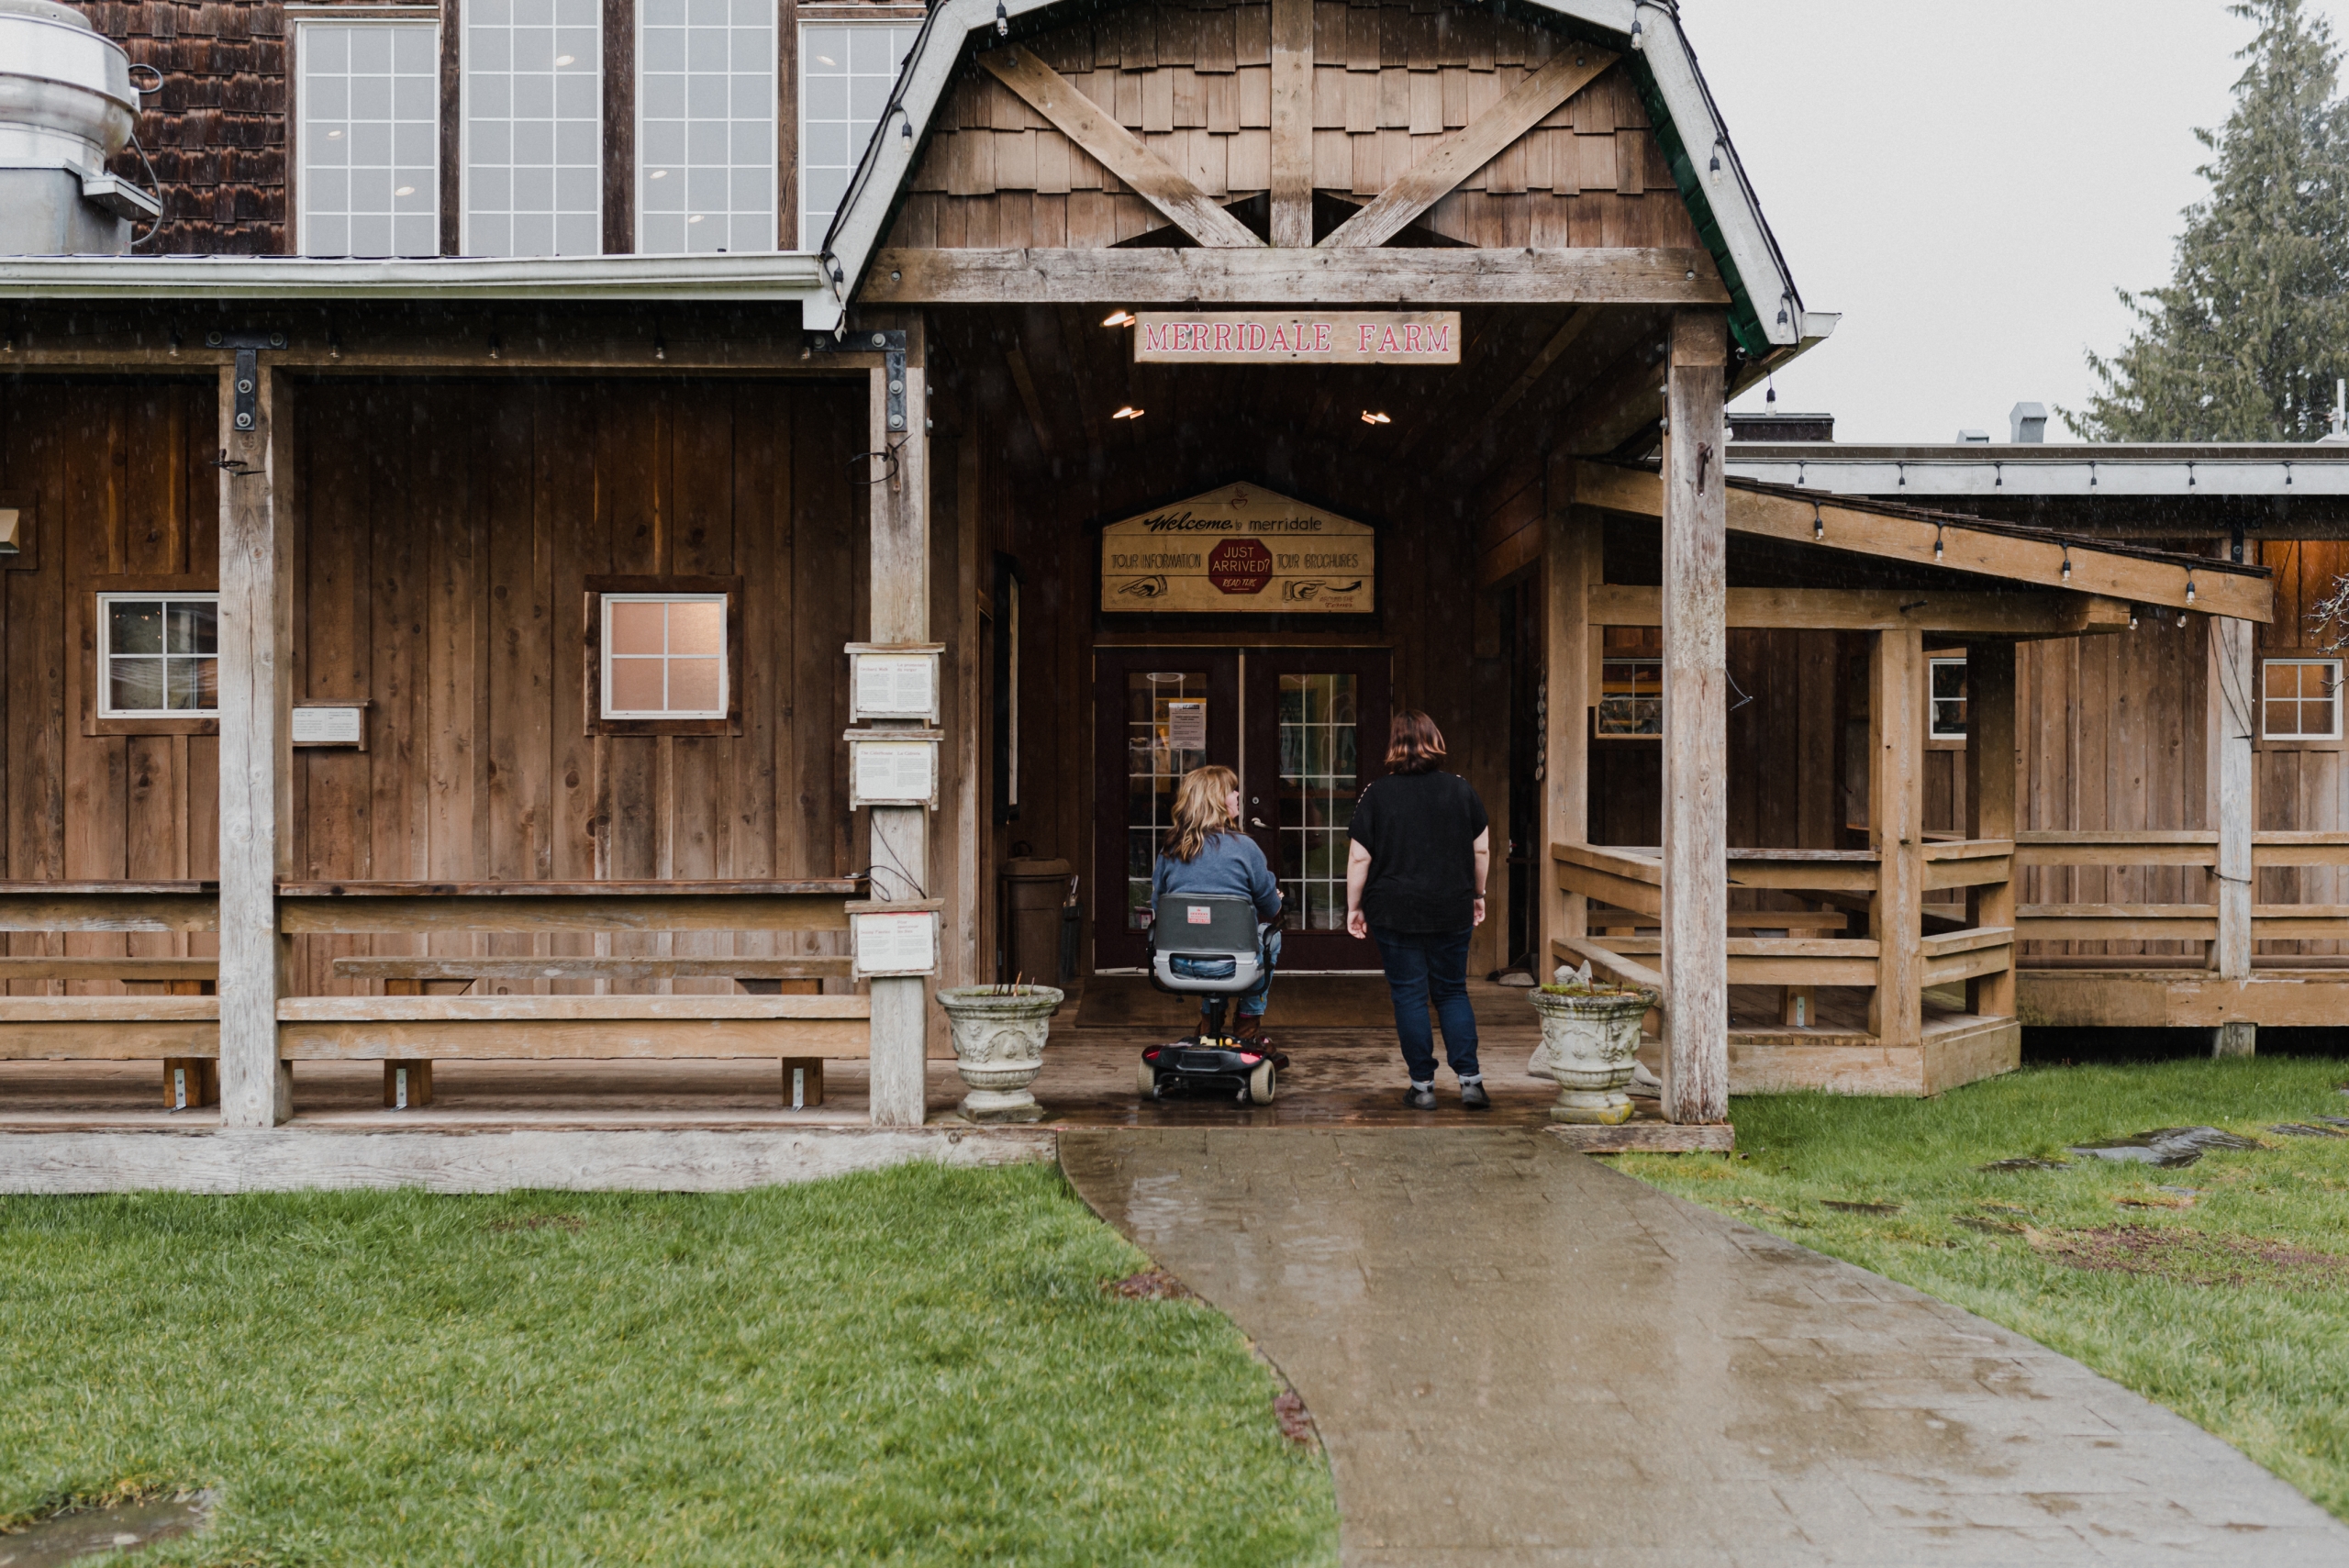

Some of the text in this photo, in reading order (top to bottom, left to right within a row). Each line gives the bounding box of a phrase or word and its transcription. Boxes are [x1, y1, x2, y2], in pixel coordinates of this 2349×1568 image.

[1145, 323, 1451, 354] MERRIDALE FARM
[1143, 511, 1323, 532] Welcome to merridale
[1111, 553, 1201, 569] TOUR INFORMATION
[1223, 547, 1254, 559] JUST
[1276, 553, 1359, 569] TOUR BROCHURES
[1211, 558, 1271, 573] ARRIVED?
[1222, 578, 1257, 587] READ THIS
